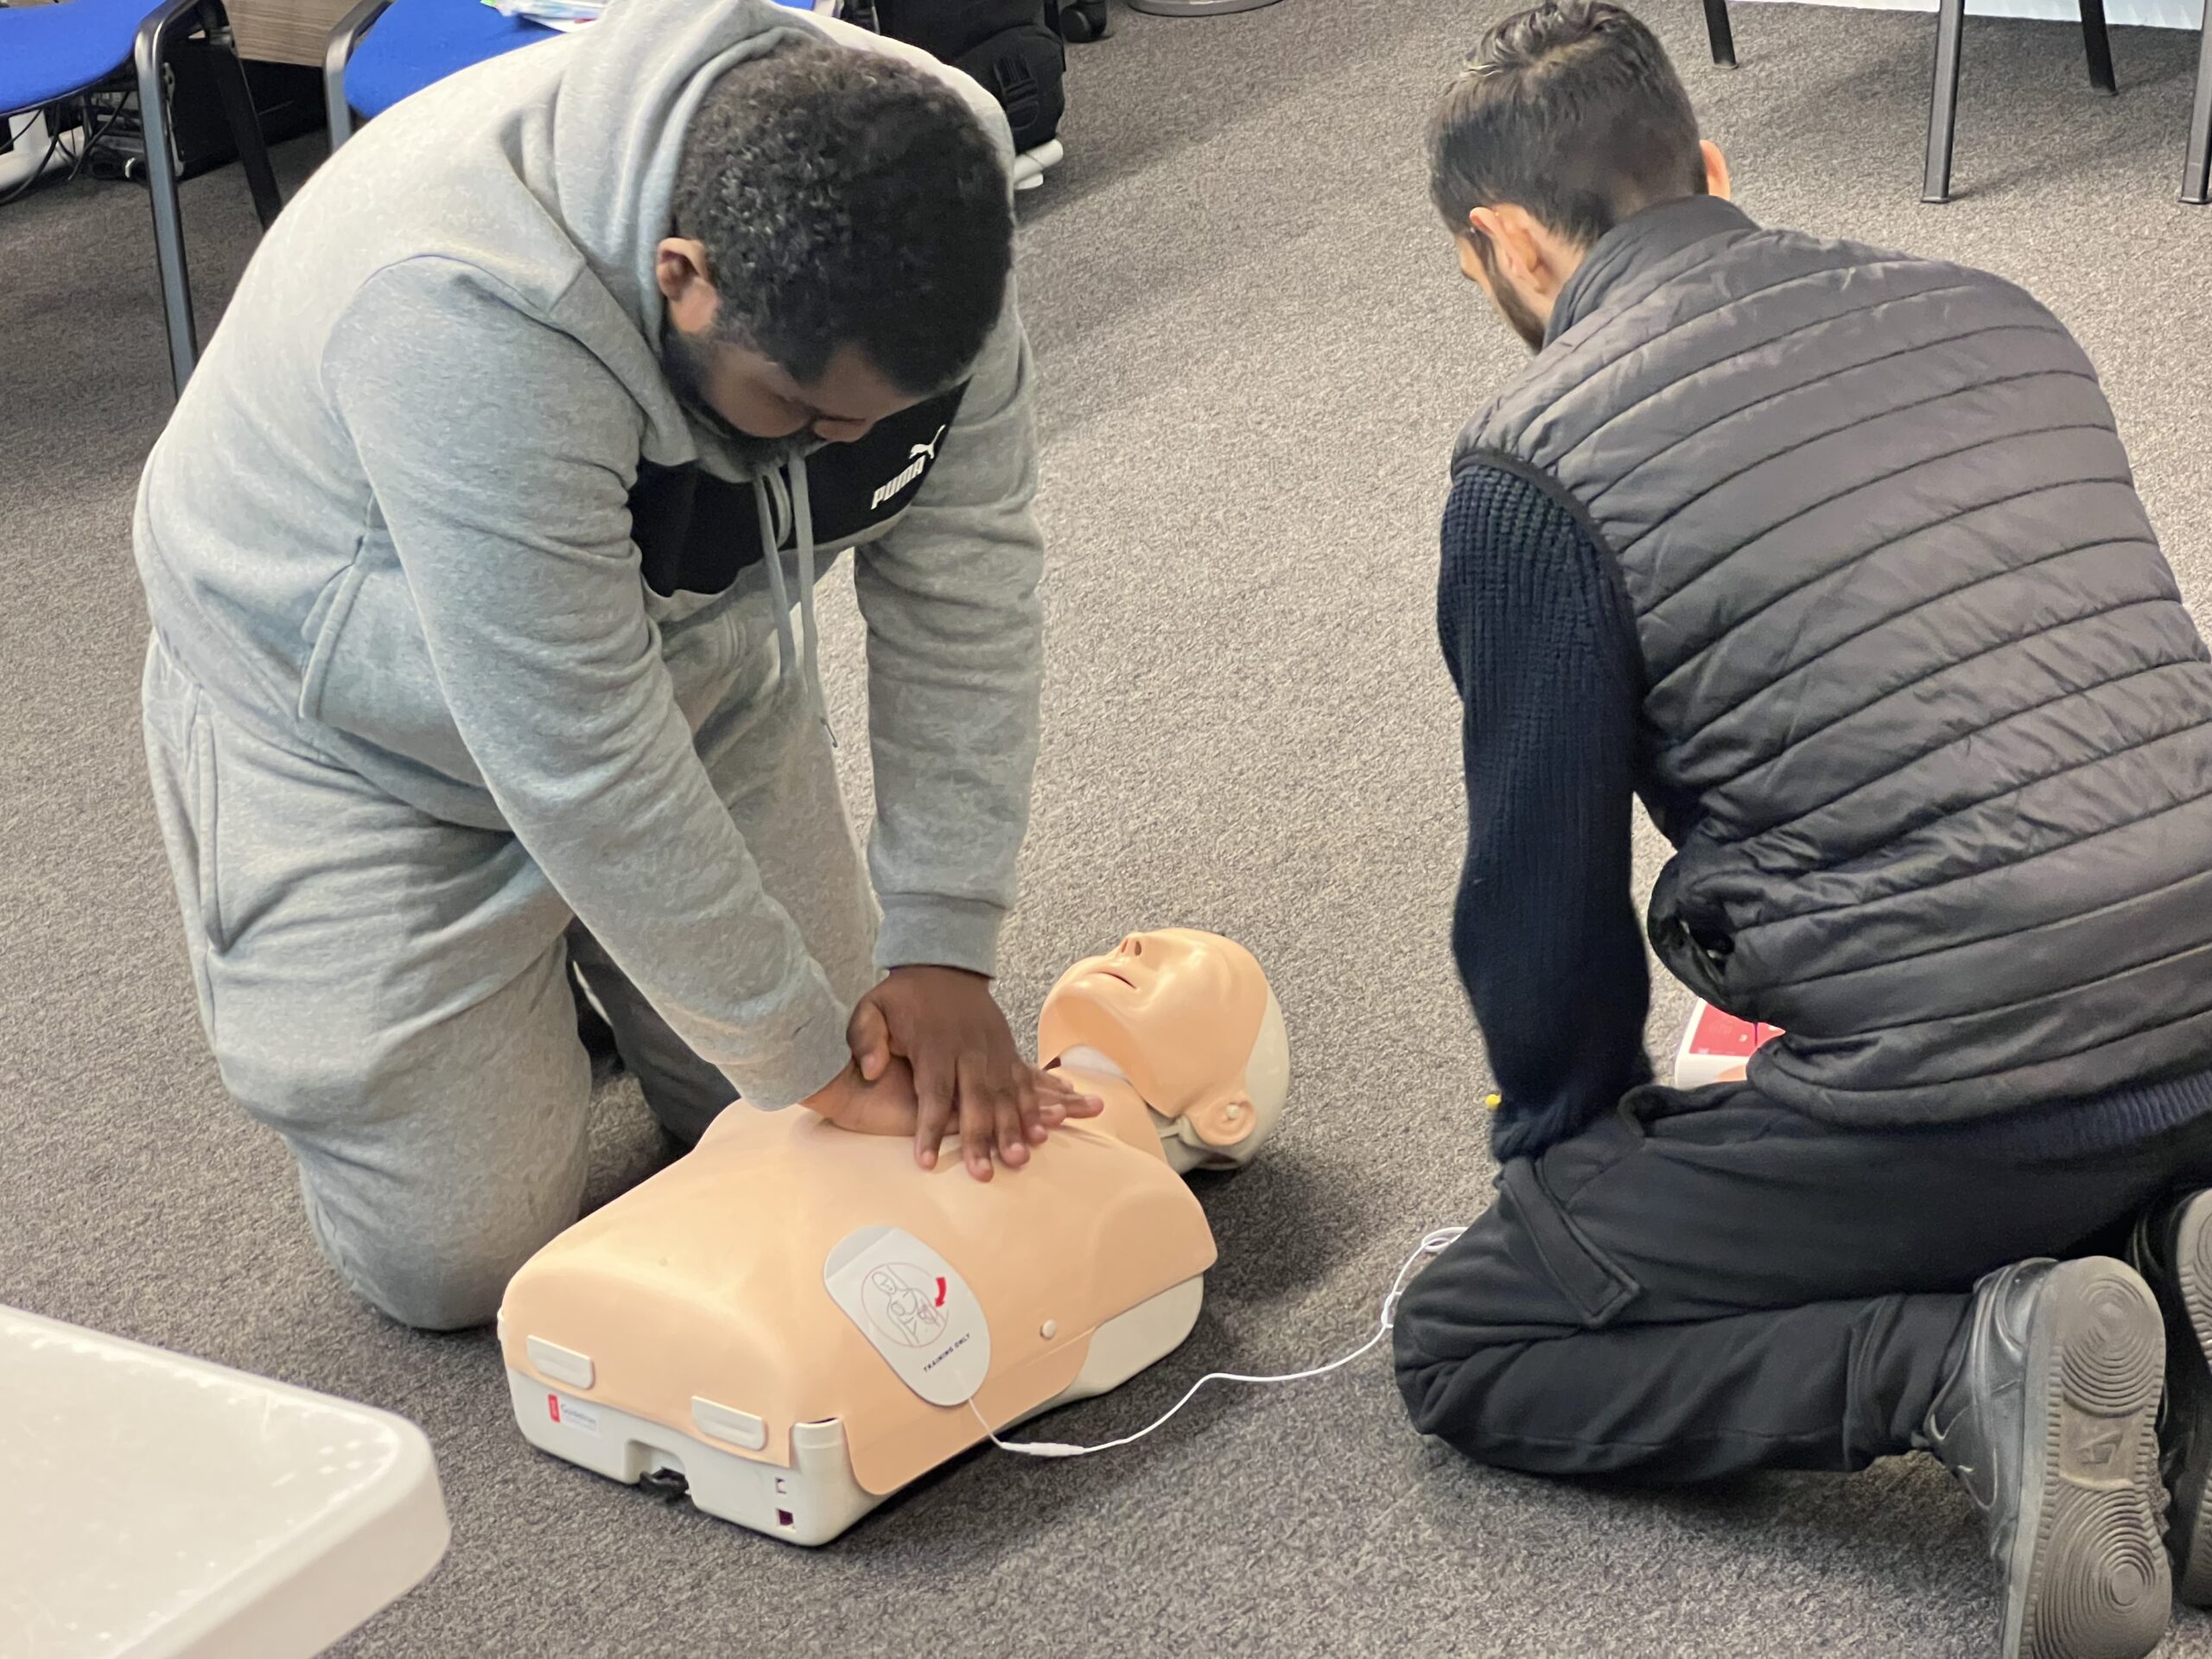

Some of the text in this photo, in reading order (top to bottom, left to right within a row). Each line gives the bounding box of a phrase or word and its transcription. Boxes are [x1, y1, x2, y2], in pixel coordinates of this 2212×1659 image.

[871, 454, 925, 510] PUMA
[923, 1332, 970, 1373] TRAINING ONLY
